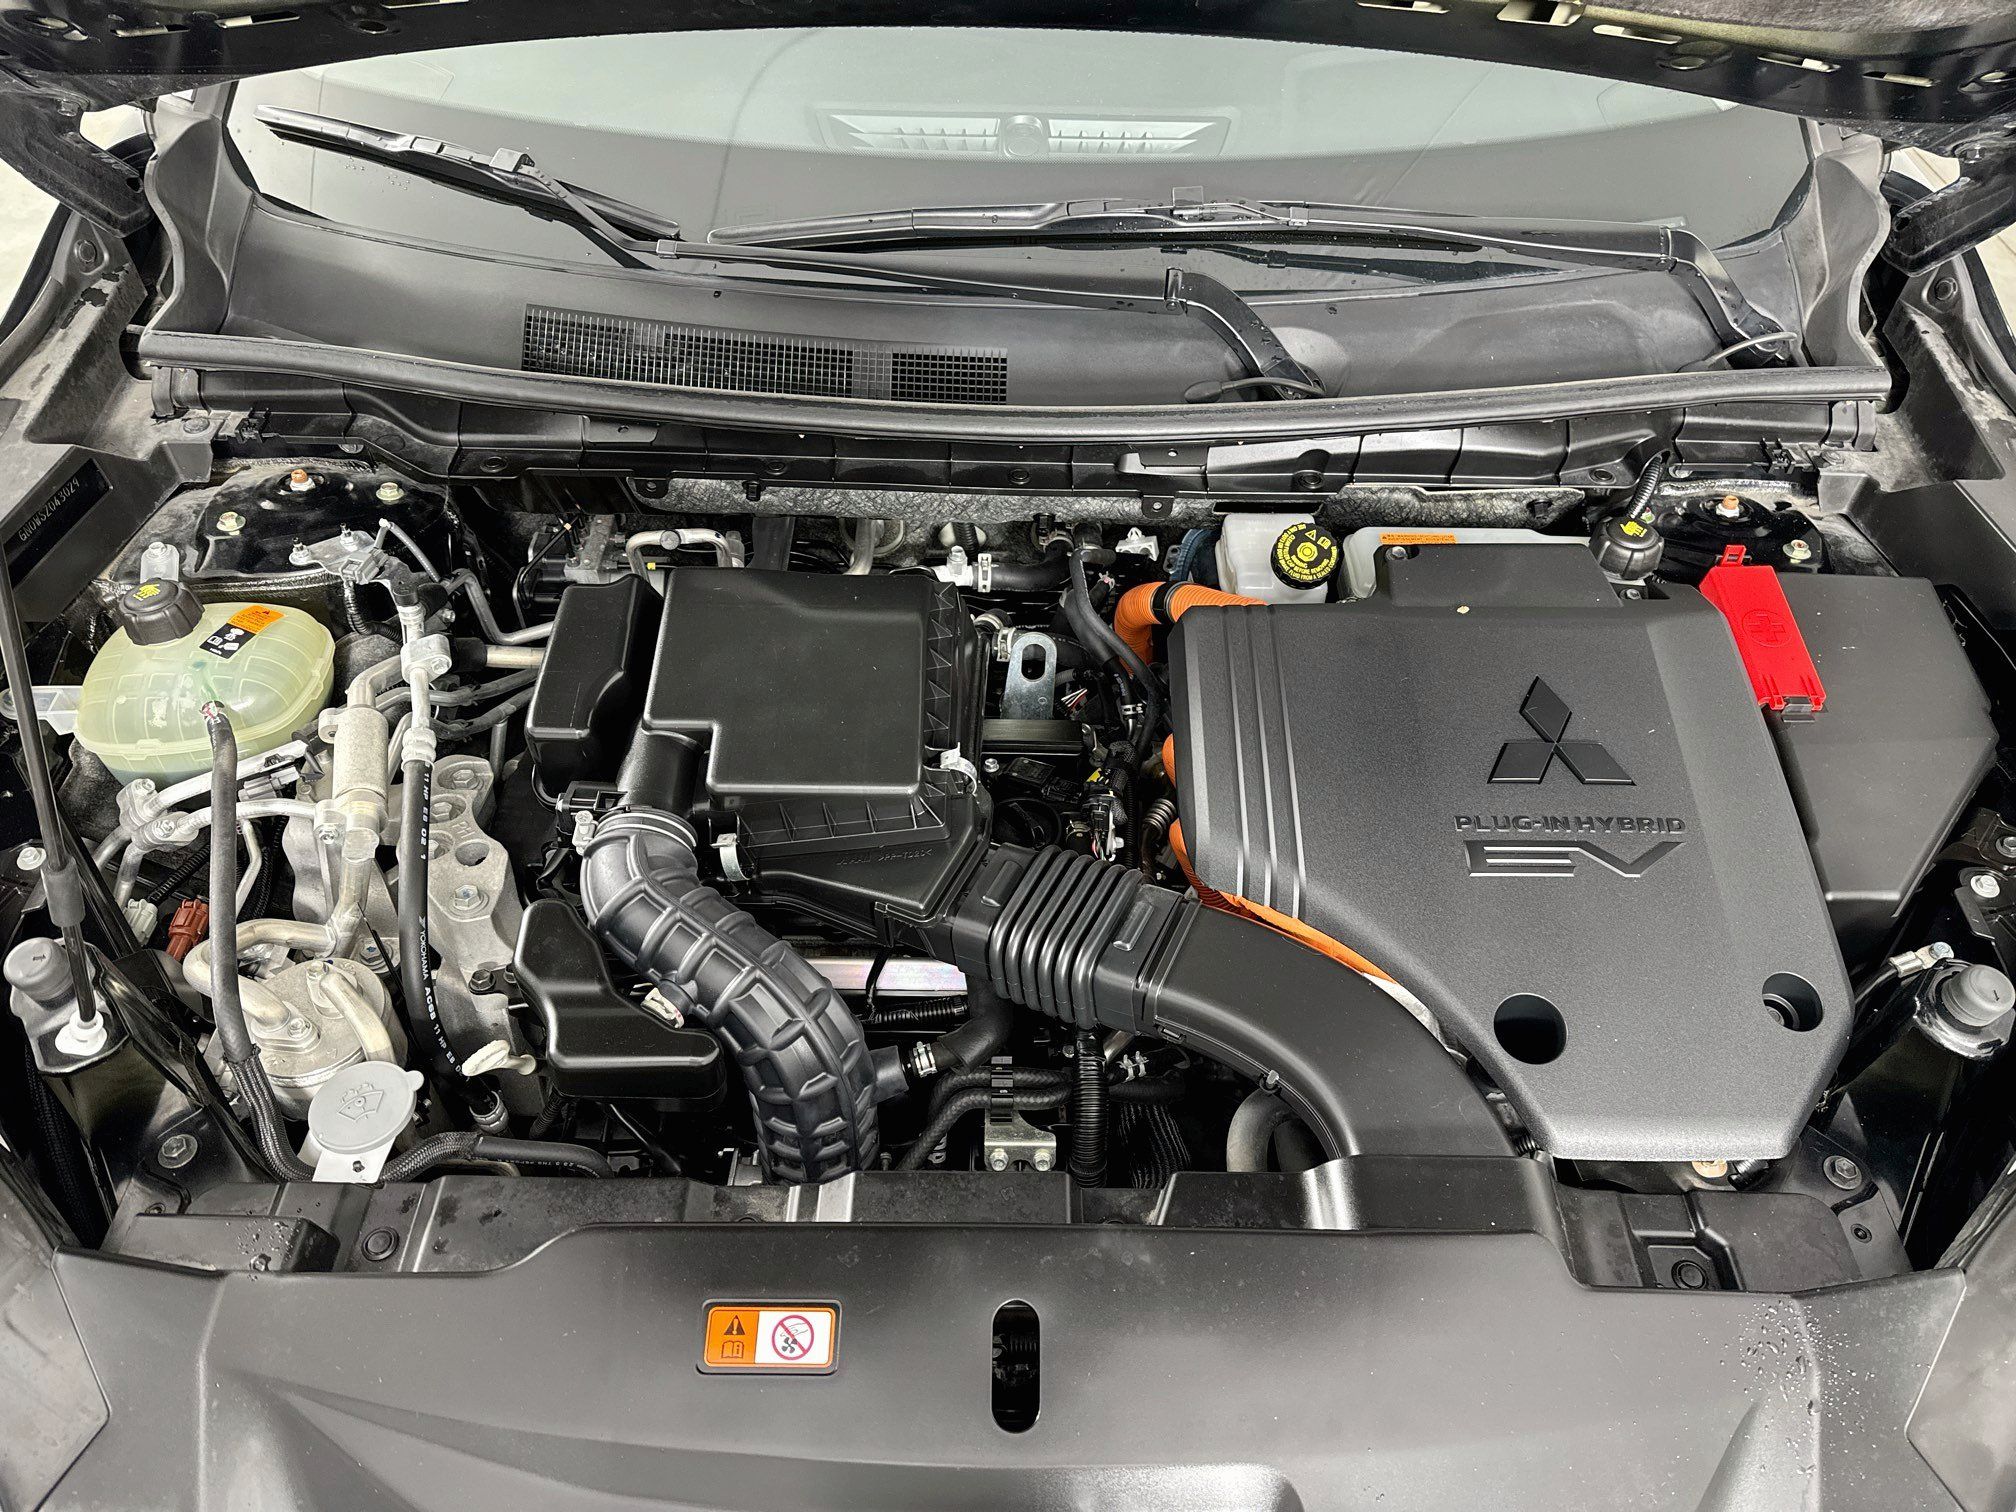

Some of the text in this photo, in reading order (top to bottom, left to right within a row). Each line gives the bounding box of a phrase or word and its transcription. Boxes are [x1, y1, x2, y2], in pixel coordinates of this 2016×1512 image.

[1453, 815, 1687, 834] PLUG-IN HYBRID
[1462, 839, 1686, 878] EV
[419, 930, 428, 981] YOKOHAMA
[437, 1036, 447, 1050] HP
